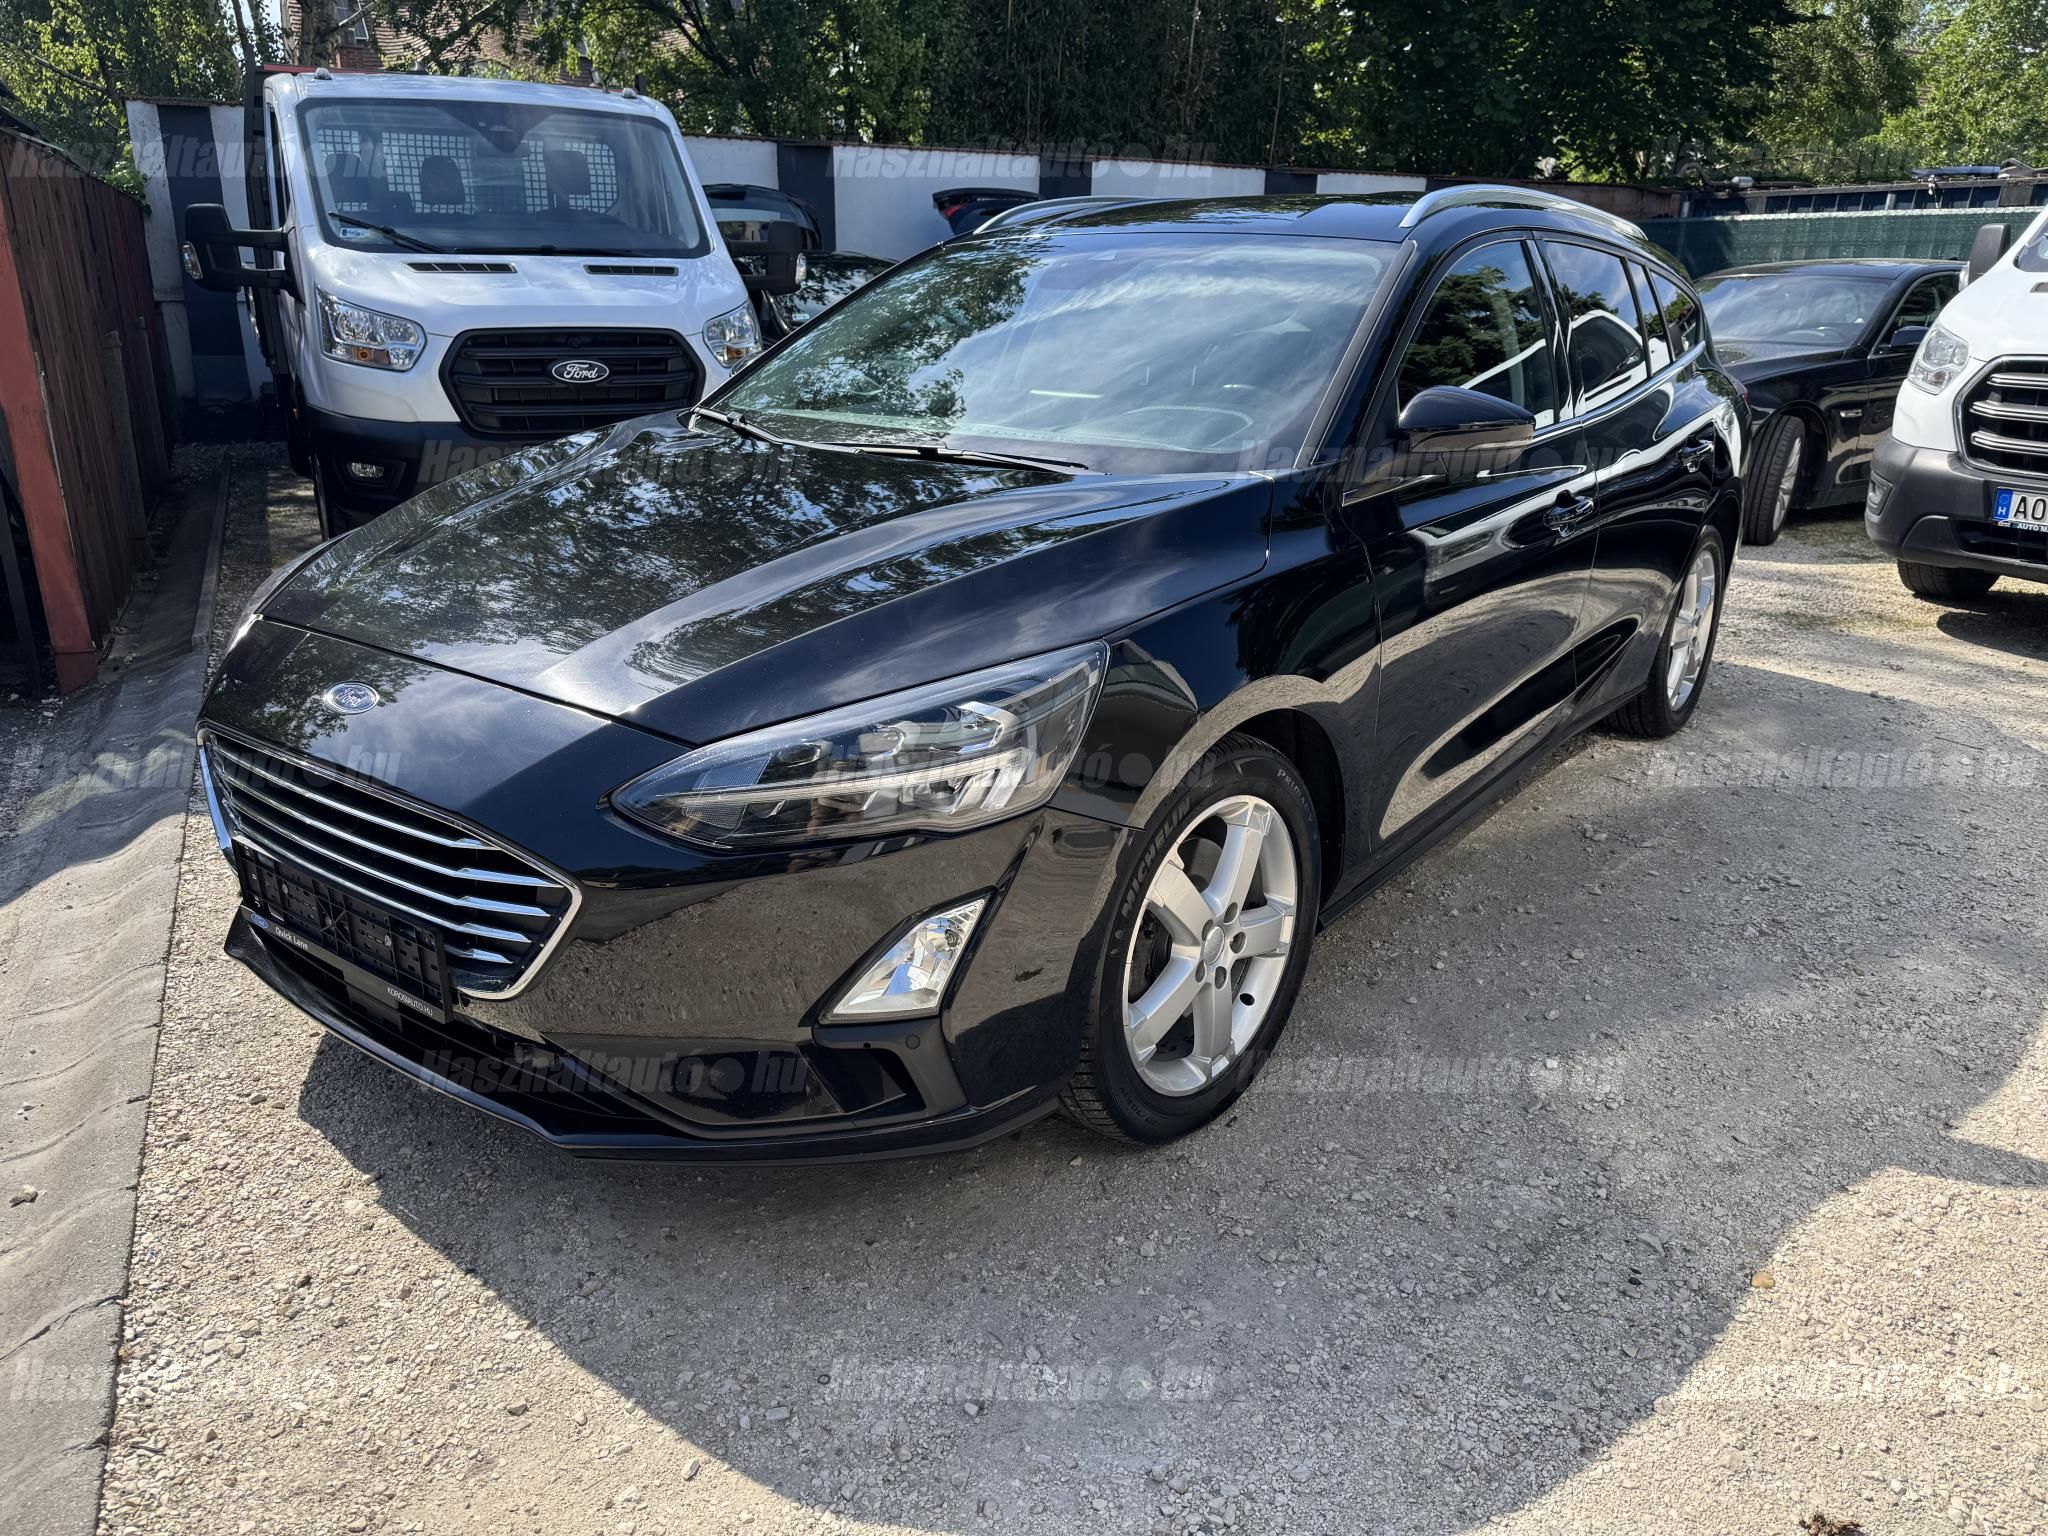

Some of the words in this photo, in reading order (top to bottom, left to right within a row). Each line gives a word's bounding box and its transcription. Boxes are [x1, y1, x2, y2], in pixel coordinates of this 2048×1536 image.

[563, 363, 598, 379] Ford
[1997, 506, 2006, 516] H
[2017, 523, 2039, 532] AUTO
[335, 687, 368, 707] Ford
[1121, 797, 1192, 918] MICHELIN
[275, 926, 292, 943] Quick
[293, 935, 309, 950] Lane
